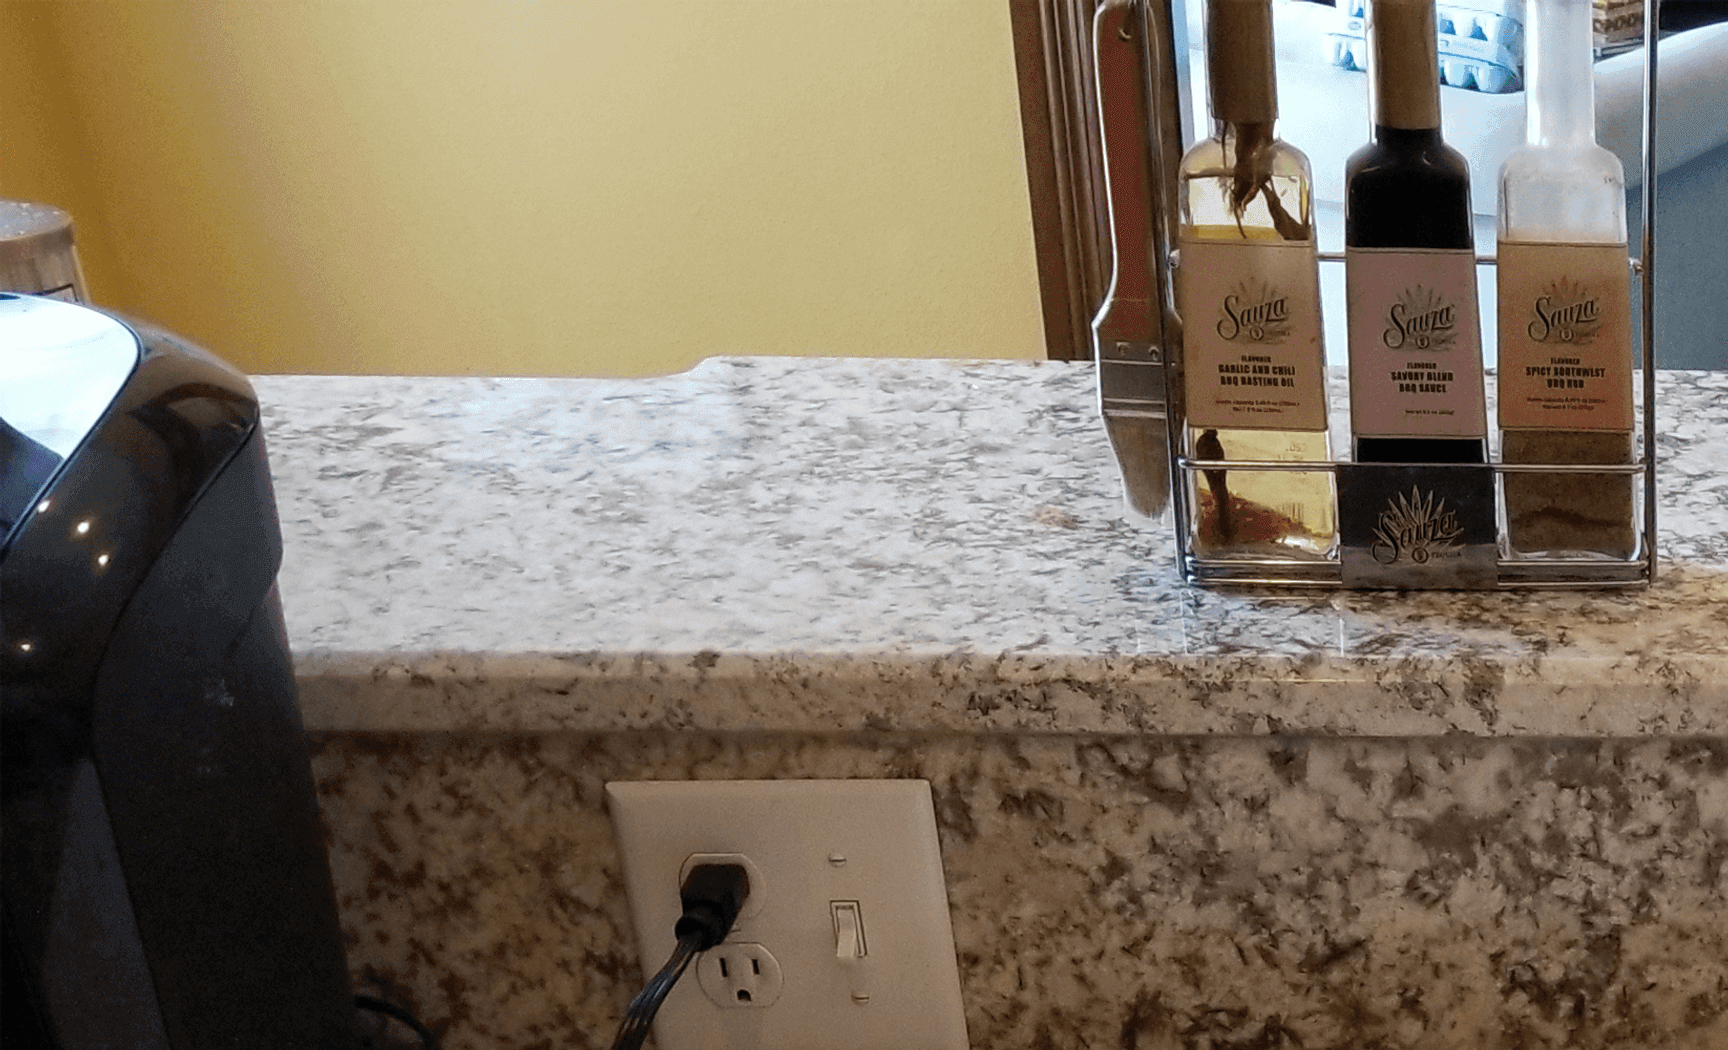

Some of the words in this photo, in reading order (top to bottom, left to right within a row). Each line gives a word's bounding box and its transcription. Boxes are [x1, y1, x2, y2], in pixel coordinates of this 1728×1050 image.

[1217, 294, 1290, 341] Sauza
[1528, 296, 1599, 342] Sauza
[1383, 303, 1455, 349] Sauza
[1218, 364, 1250, 374] GARLIC
[1252, 365, 1270, 374] AND
[1272, 366, 1296, 375] CHILI
[1526, 366, 1551, 376] SPICY
[1554, 367, 1606, 377] SOUTHWEST
[1220, 376, 1239, 386] BBQ
[1241, 376, 1279, 387] BASTING
[1281, 378, 1295, 387] OIL
[1391, 371, 1425, 381] SAVORY
[1427, 372, 1454, 381] BLEND
[1399, 383, 1417, 393] BBQ
[1419, 383, 1447, 393] SAUCE
[1547, 378, 1565, 389] BBQ
[1373, 509, 1458, 564] Sauza
